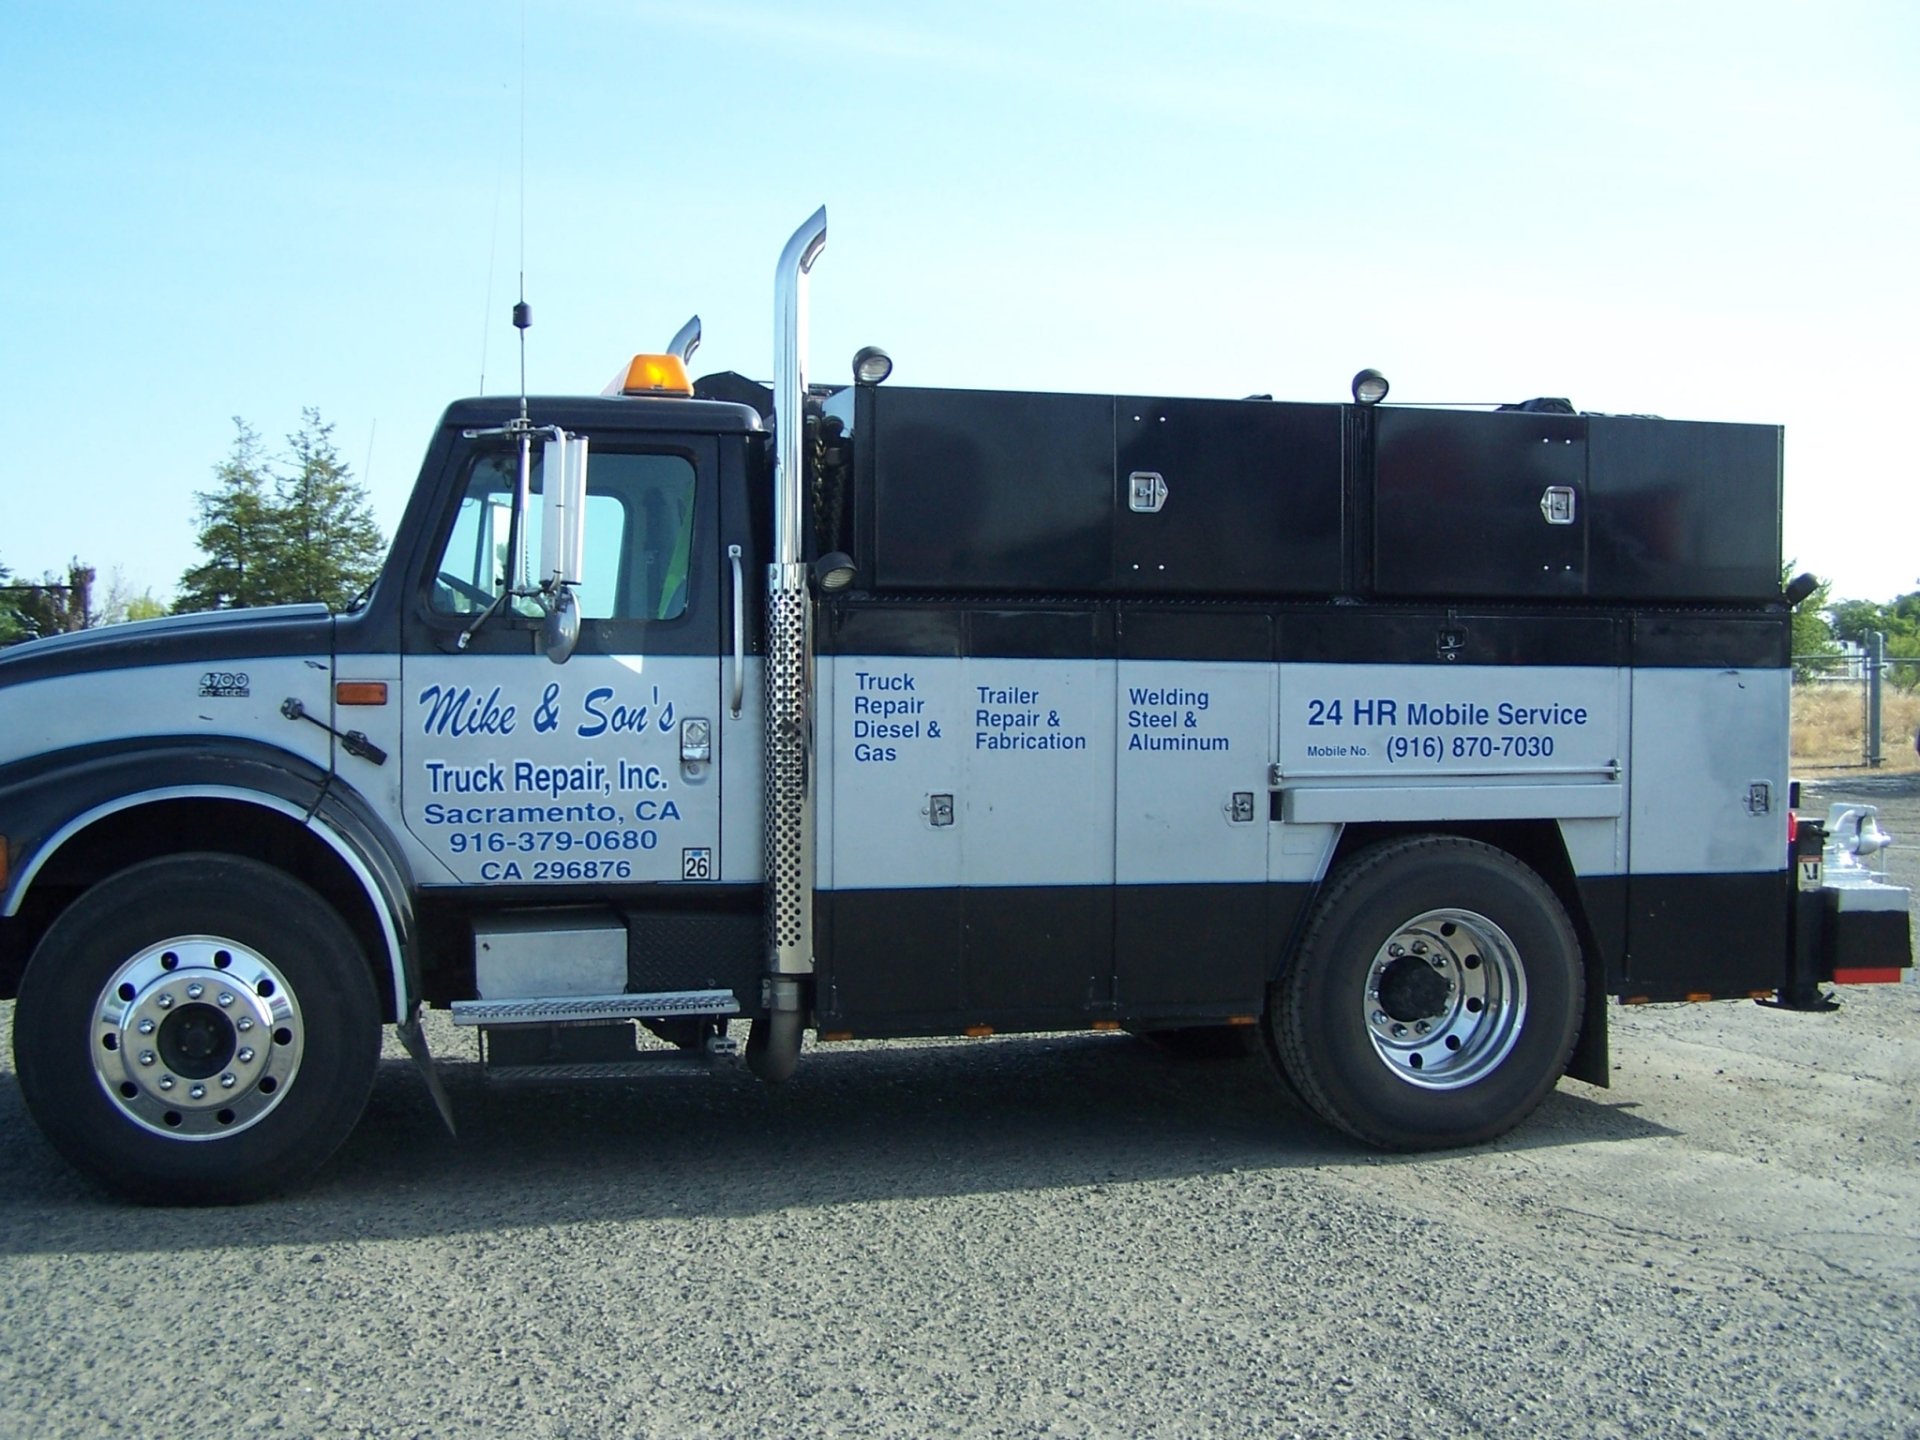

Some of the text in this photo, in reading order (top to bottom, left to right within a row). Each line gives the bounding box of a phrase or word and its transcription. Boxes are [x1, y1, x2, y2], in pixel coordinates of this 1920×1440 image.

[200, 672, 249, 688] 4700
[855, 673, 915, 691] Truck
[977, 687, 1039, 704] Trailer
[1129, 689, 1209, 709] Welding
[420, 683, 675, 736] Mike & Son's
[855, 697, 925, 718] Repair
[1308, 699, 1587, 725] 24 HR Mobile Service
[976, 710, 1060, 731] Repair &
[1128, 711, 1197, 728] Steel &
[855, 721, 941, 738] Diesel &
[976, 733, 1085, 750] Fabrication
[1128, 734, 1229, 751] Aluminum
[1307, 736, 1554, 762] Mobile No. (916) 870-7030
[855, 744, 896, 761] Gas
[426, 761, 667, 797] Truck Repair, Inc.
[425, 801, 681, 824] Sacramento, CA
[450, 830, 657, 852] 916-379-0680
[481, 861, 631, 880] CA 296876
[686, 858, 707, 877] 26
